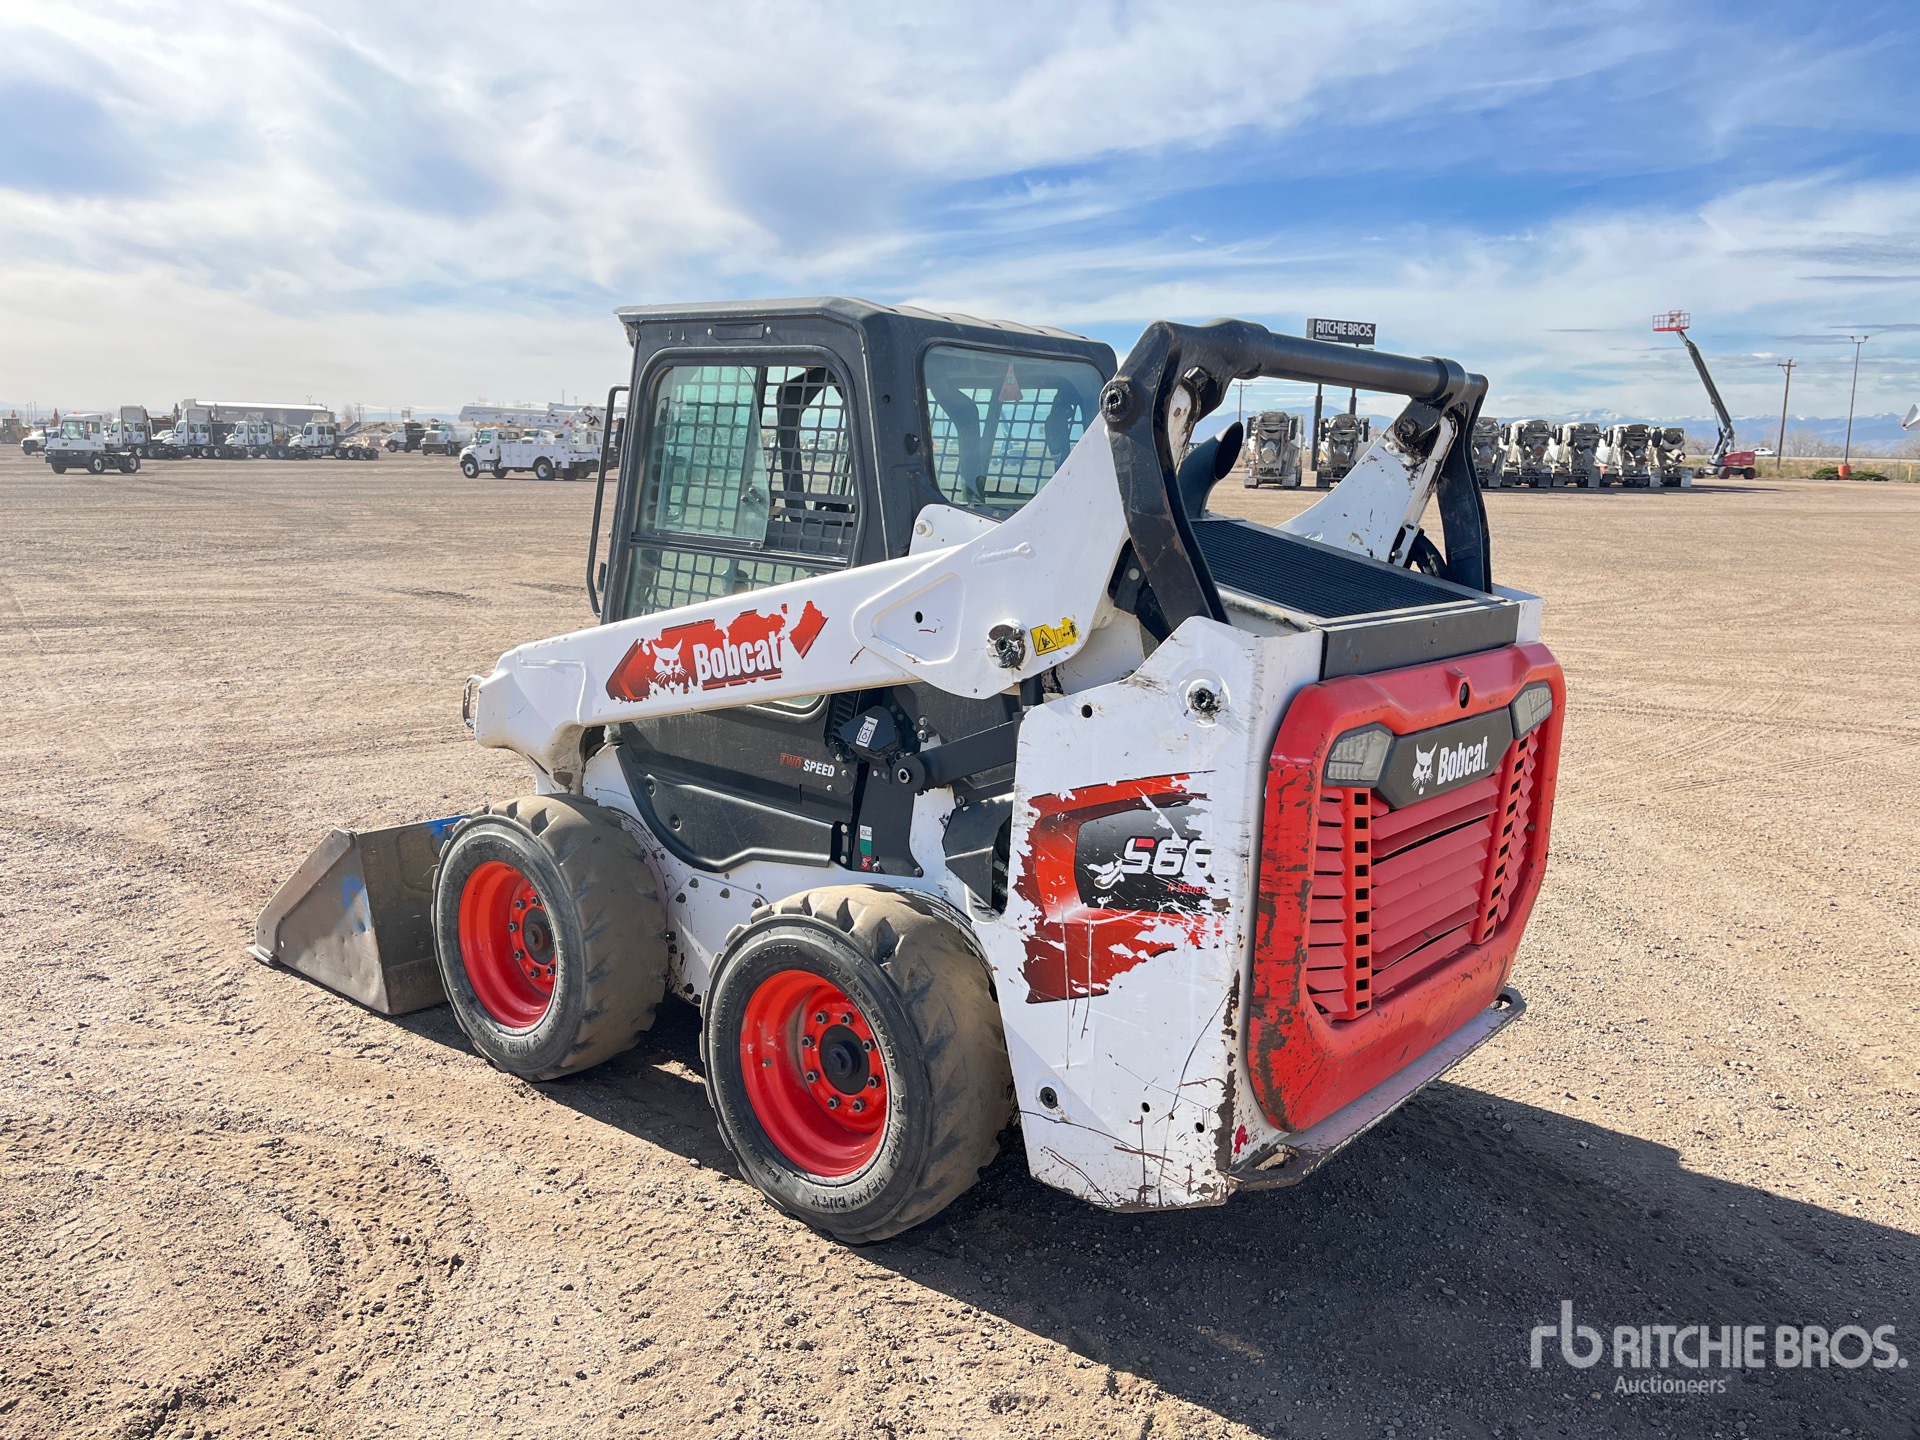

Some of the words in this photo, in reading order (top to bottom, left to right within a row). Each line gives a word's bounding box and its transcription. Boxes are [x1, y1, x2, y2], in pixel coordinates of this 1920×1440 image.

[1315, 321, 1347, 335] RITCHIE
[1347, 323, 1374, 337] BROS.
[693, 630, 782, 681] Bobcat
[780, 753, 802, 769] TWO
[803, 759, 836, 778] SPEED
[1436, 735, 1489, 786] Bobcat
